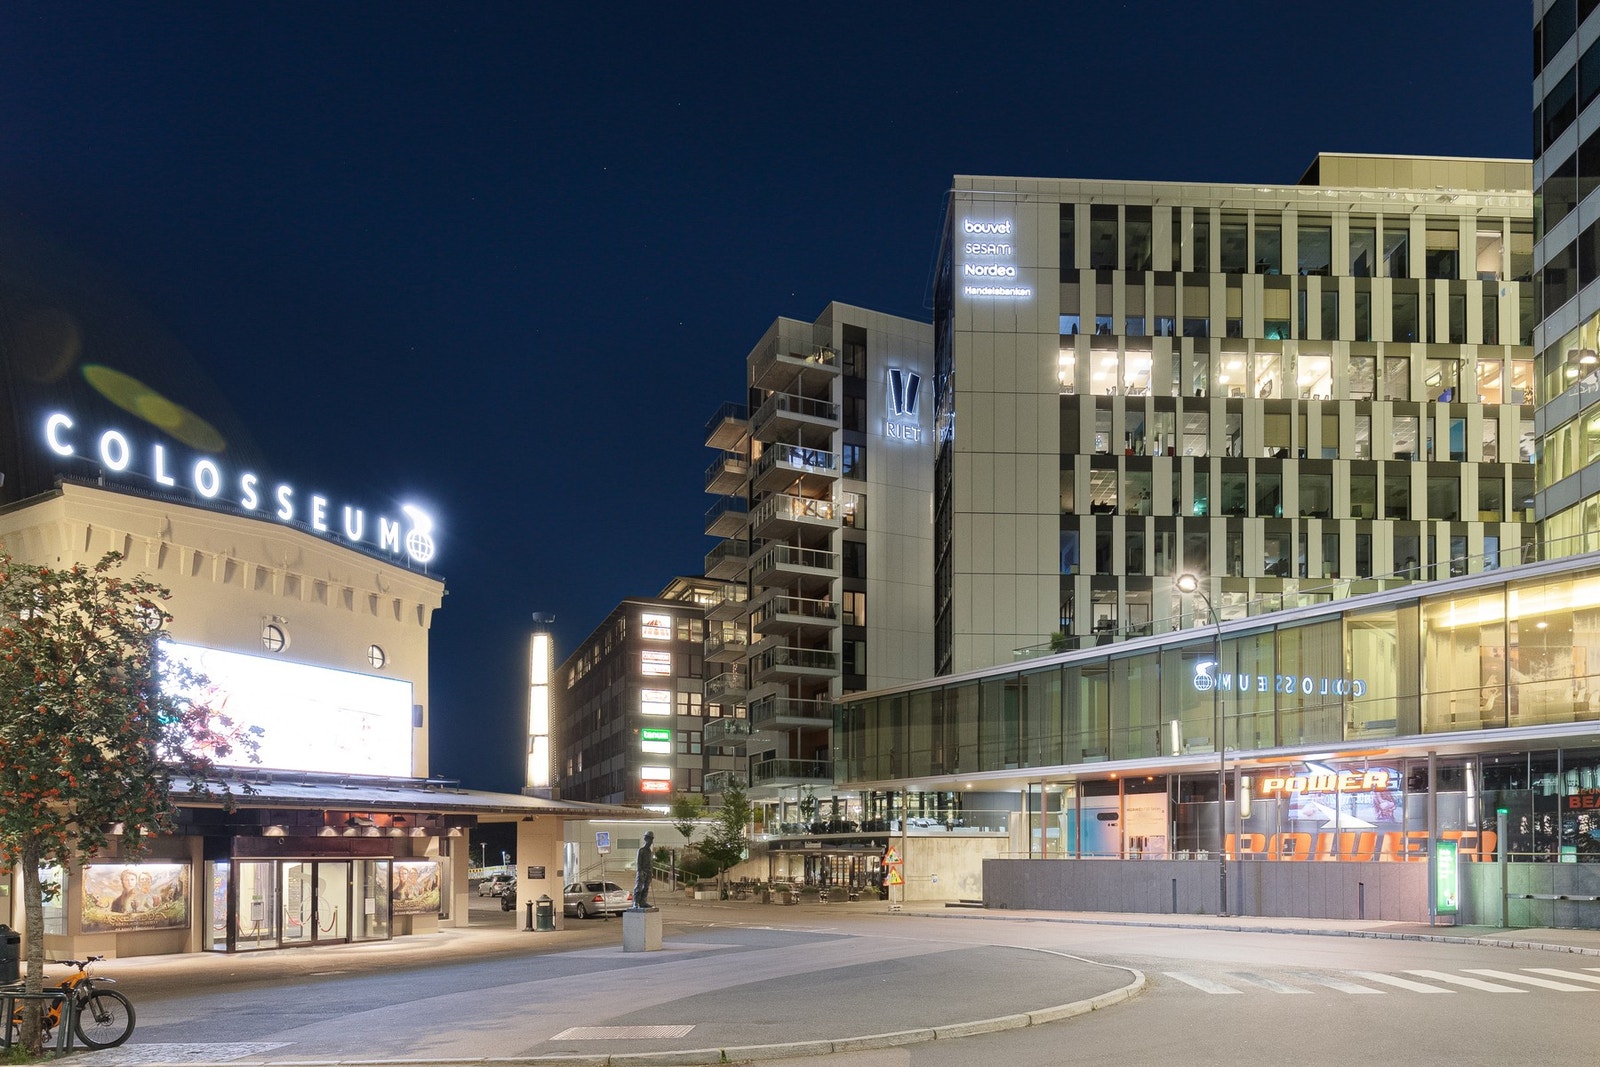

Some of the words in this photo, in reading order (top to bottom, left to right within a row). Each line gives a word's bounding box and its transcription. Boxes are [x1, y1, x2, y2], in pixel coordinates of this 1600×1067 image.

[964, 219, 1011, 234] bouvet
[964, 264, 1016, 277] Nordea
[964, 286, 1031, 296] Handelsbanken
[886, 421, 921, 442] RIET
[45, 412, 400, 554] COLOSSEUM
[1262, 771, 1390, 794] POWER
[1224, 830, 1498, 863] POWER
